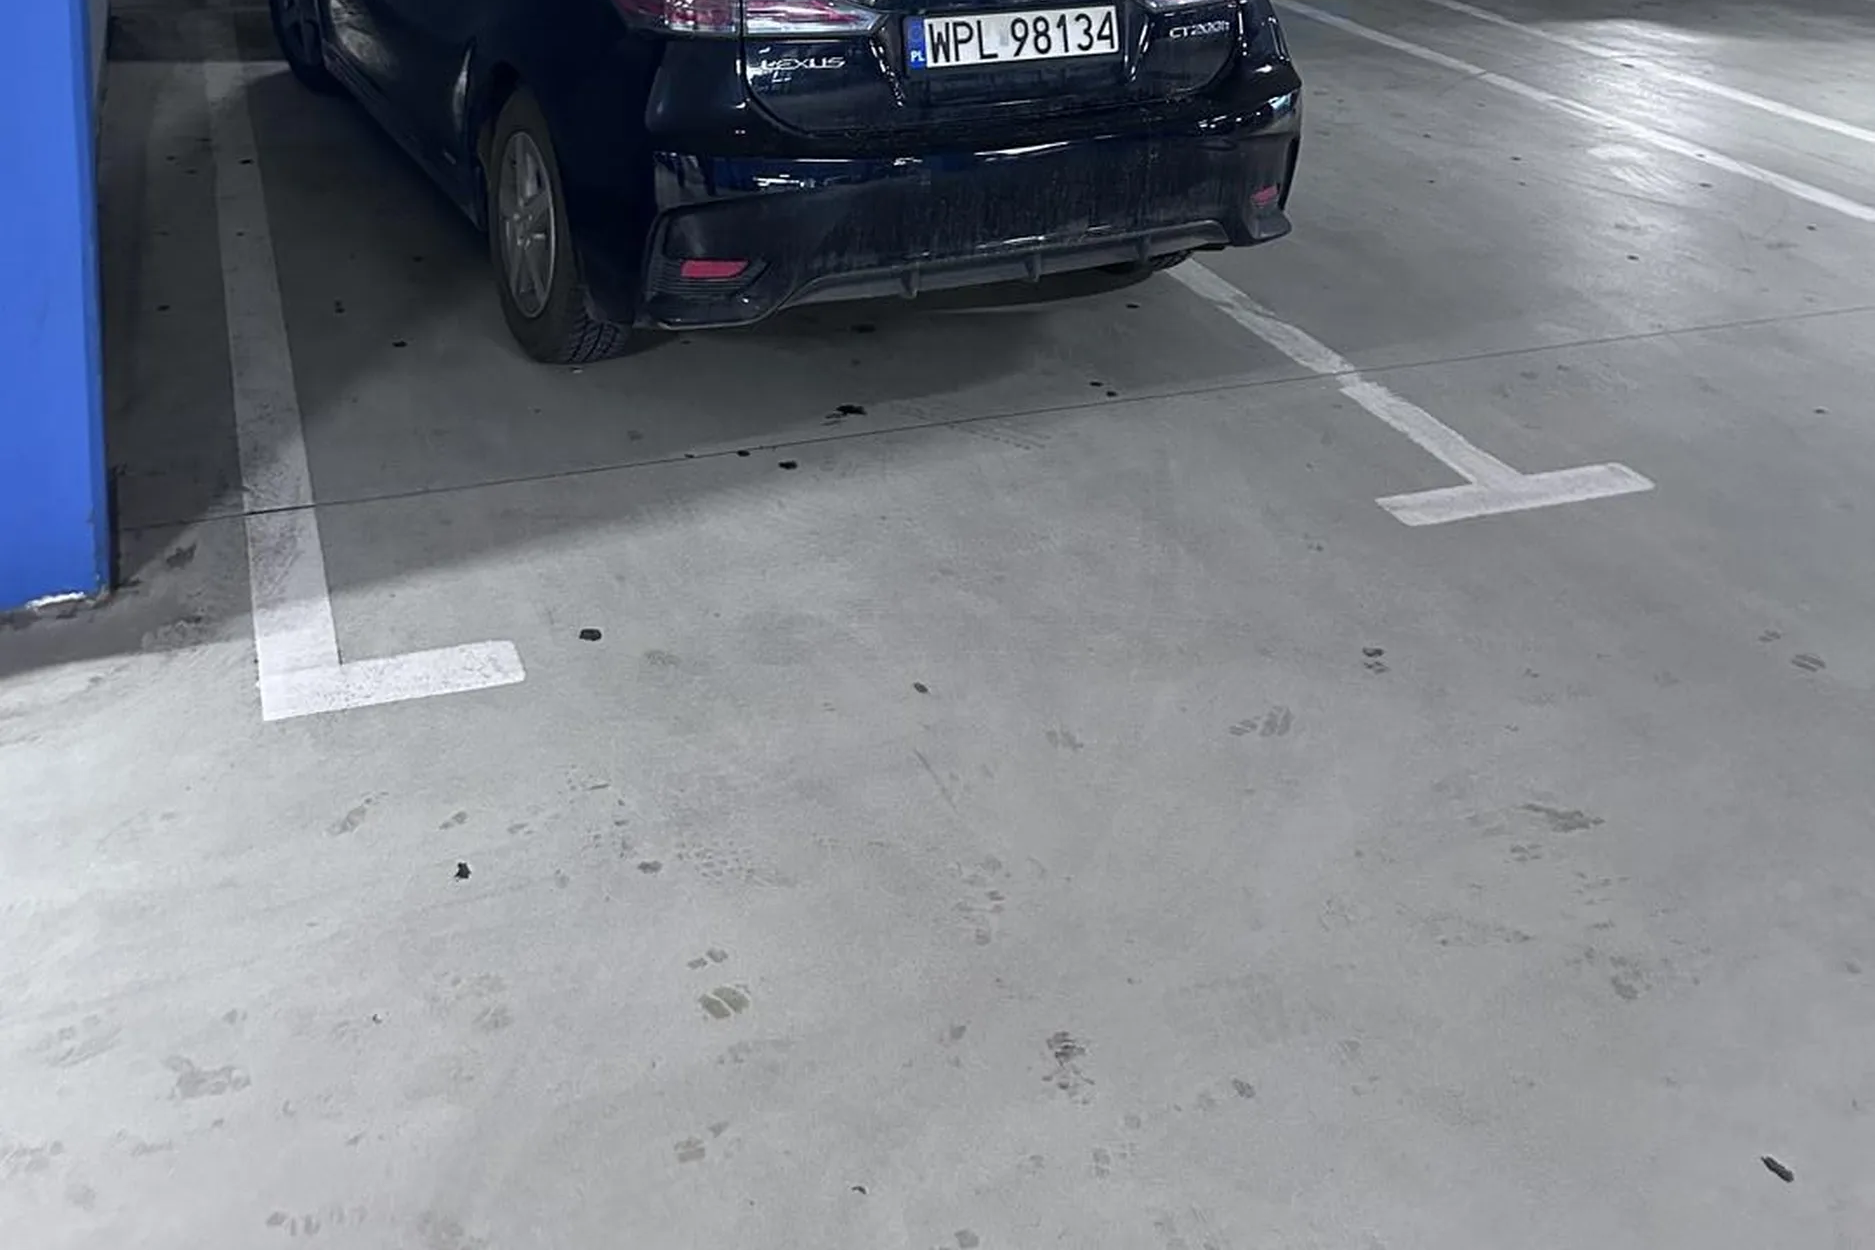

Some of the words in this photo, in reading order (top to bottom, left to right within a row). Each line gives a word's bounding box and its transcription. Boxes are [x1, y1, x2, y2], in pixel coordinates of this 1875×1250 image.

[928, 20, 998, 64] WPL
[1010, 10, 1115, 57] 98134
[760, 56, 846, 70] LEXUS
[910, 51, 925, 62] PL
